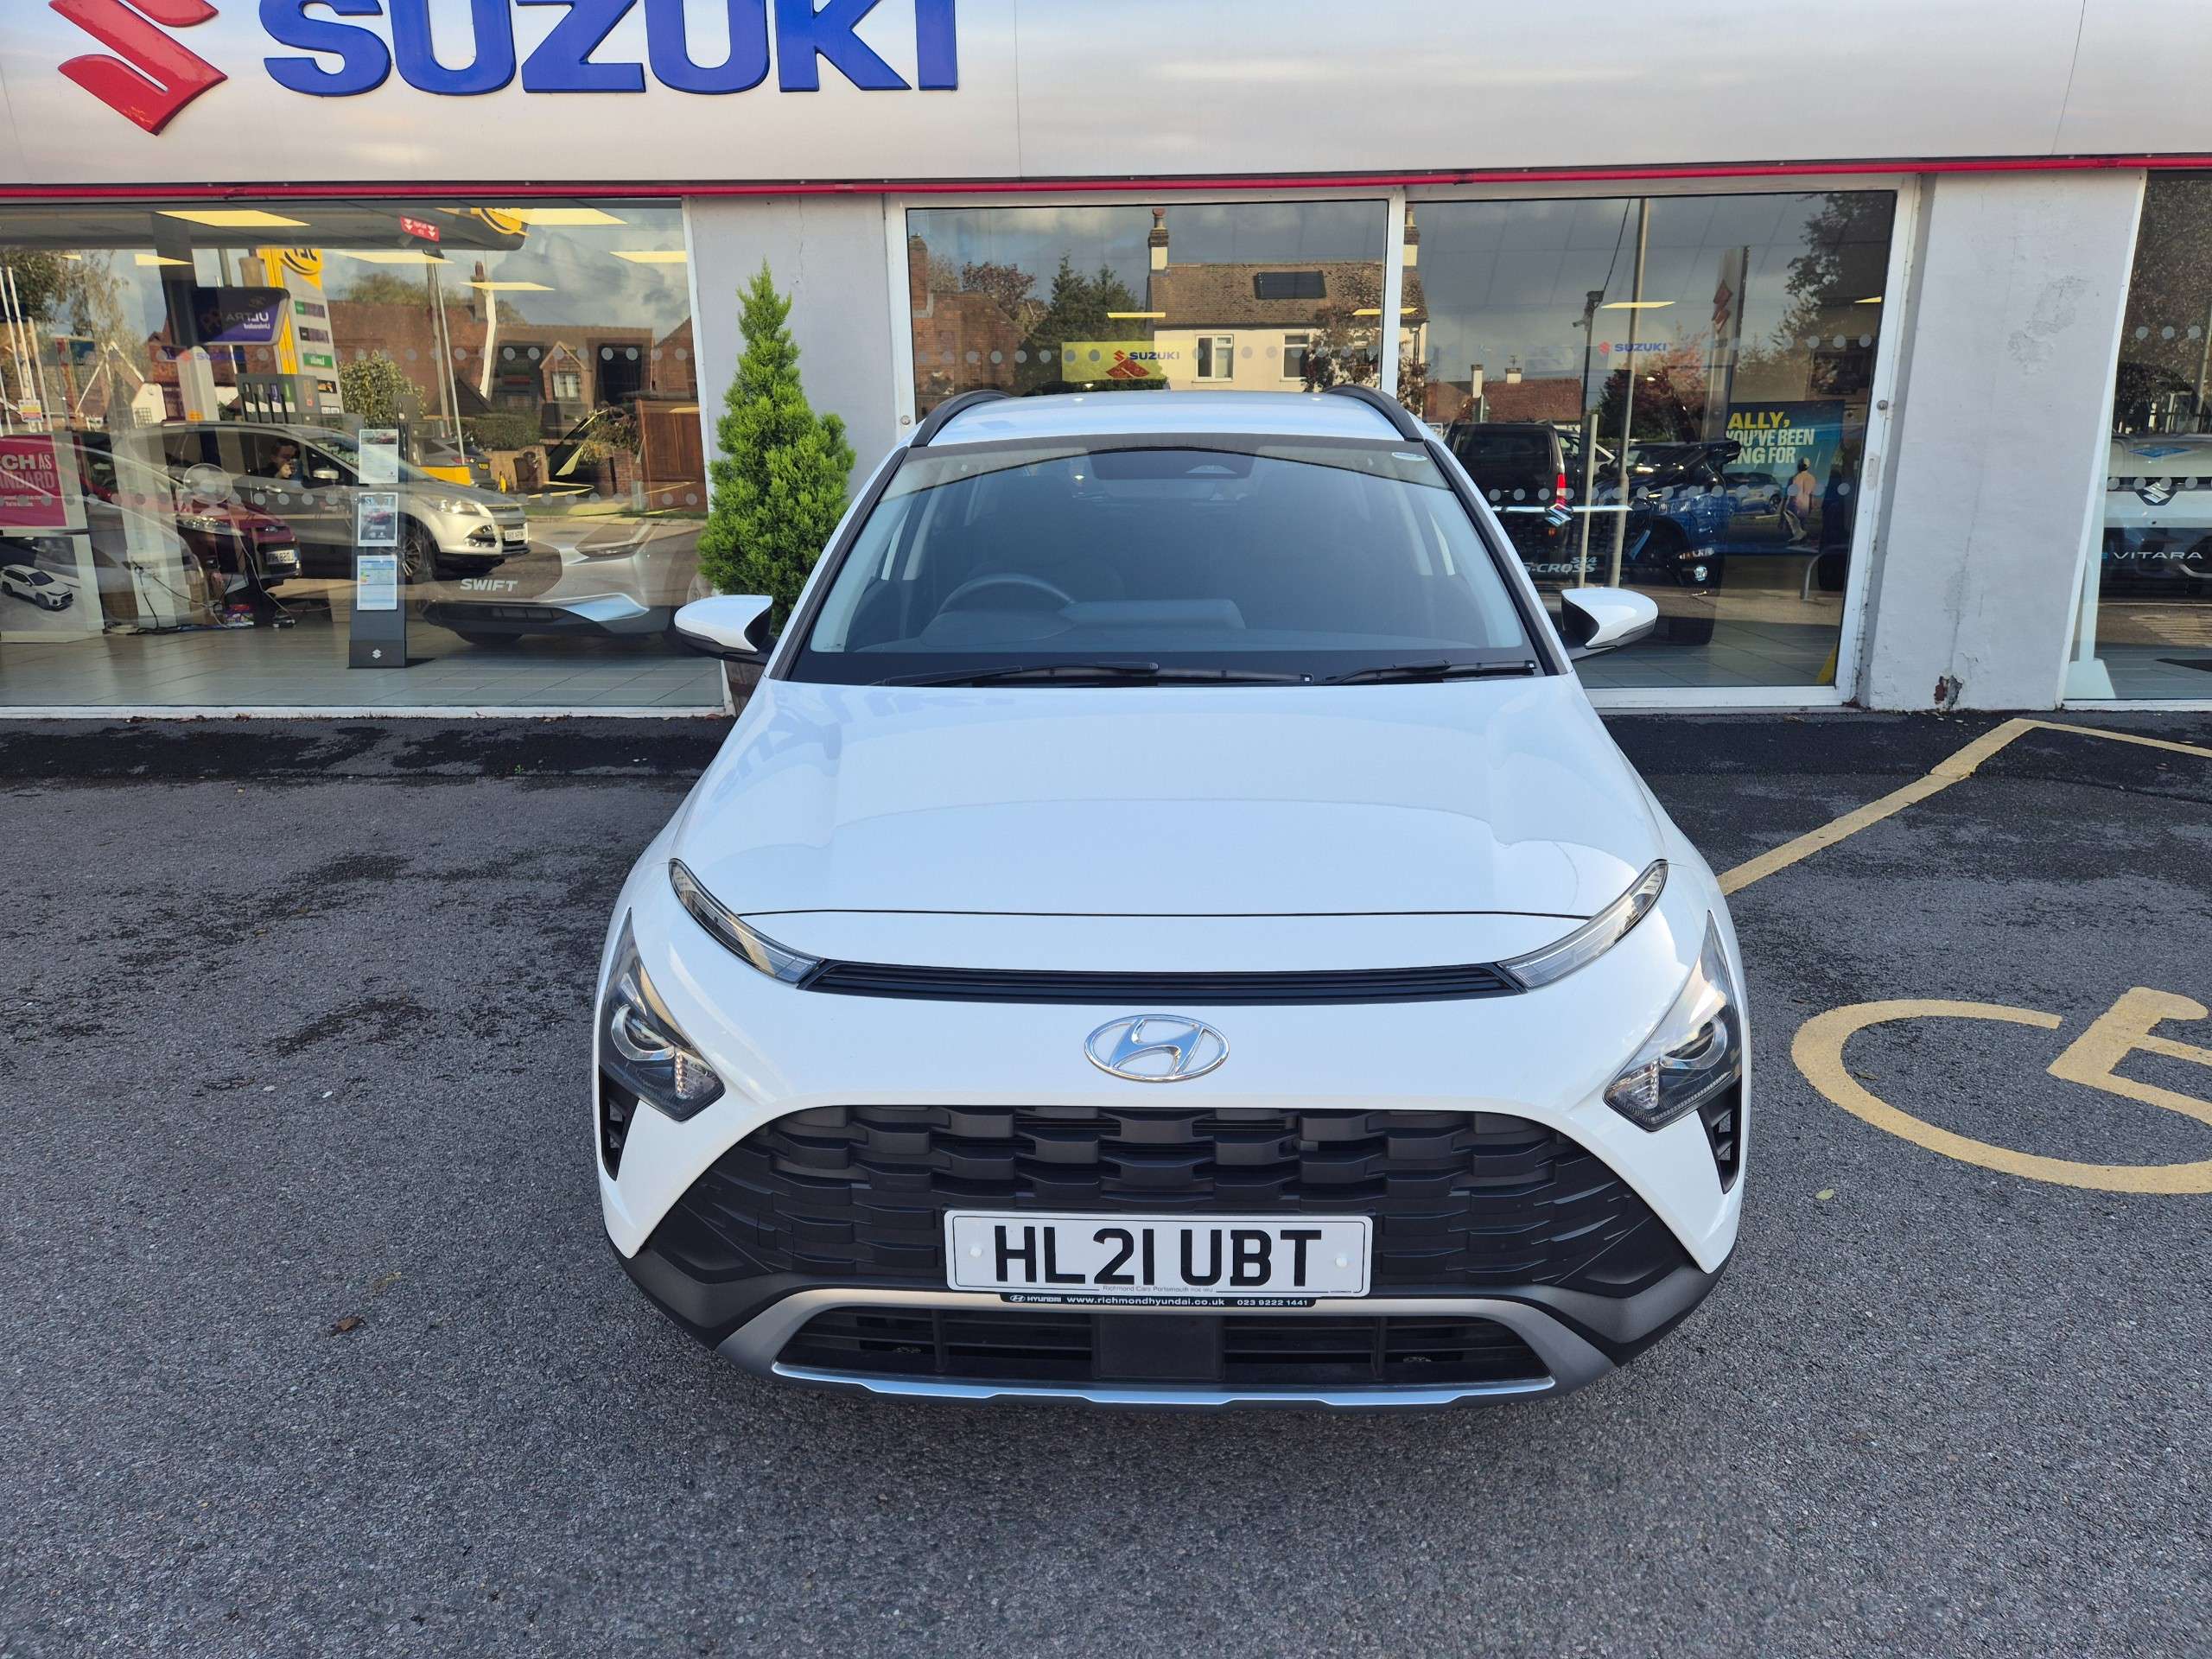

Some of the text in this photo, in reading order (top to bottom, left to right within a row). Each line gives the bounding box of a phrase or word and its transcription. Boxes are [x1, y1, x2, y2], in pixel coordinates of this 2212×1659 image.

[264, 0, 959, 97] SUZUKI
[1614, 342, 1667, 353] SUZUKI
[1128, 351, 1180, 360] SUZUKI
[1726, 428, 1815, 448] YOU'VE BEEN
[38, 453, 53, 470] AS
[1728, 446, 1796, 465] NG FOR
[2113, 551, 2203, 560] VITARA
[460, 578, 518, 592] SWIFT
[994, 1224, 1322, 1287] HL21 UBT
[1103, 1284, 1135, 1293] Richmond
[1066, 1296, 1225, 1306] www.richmondhyundai.co.uk
